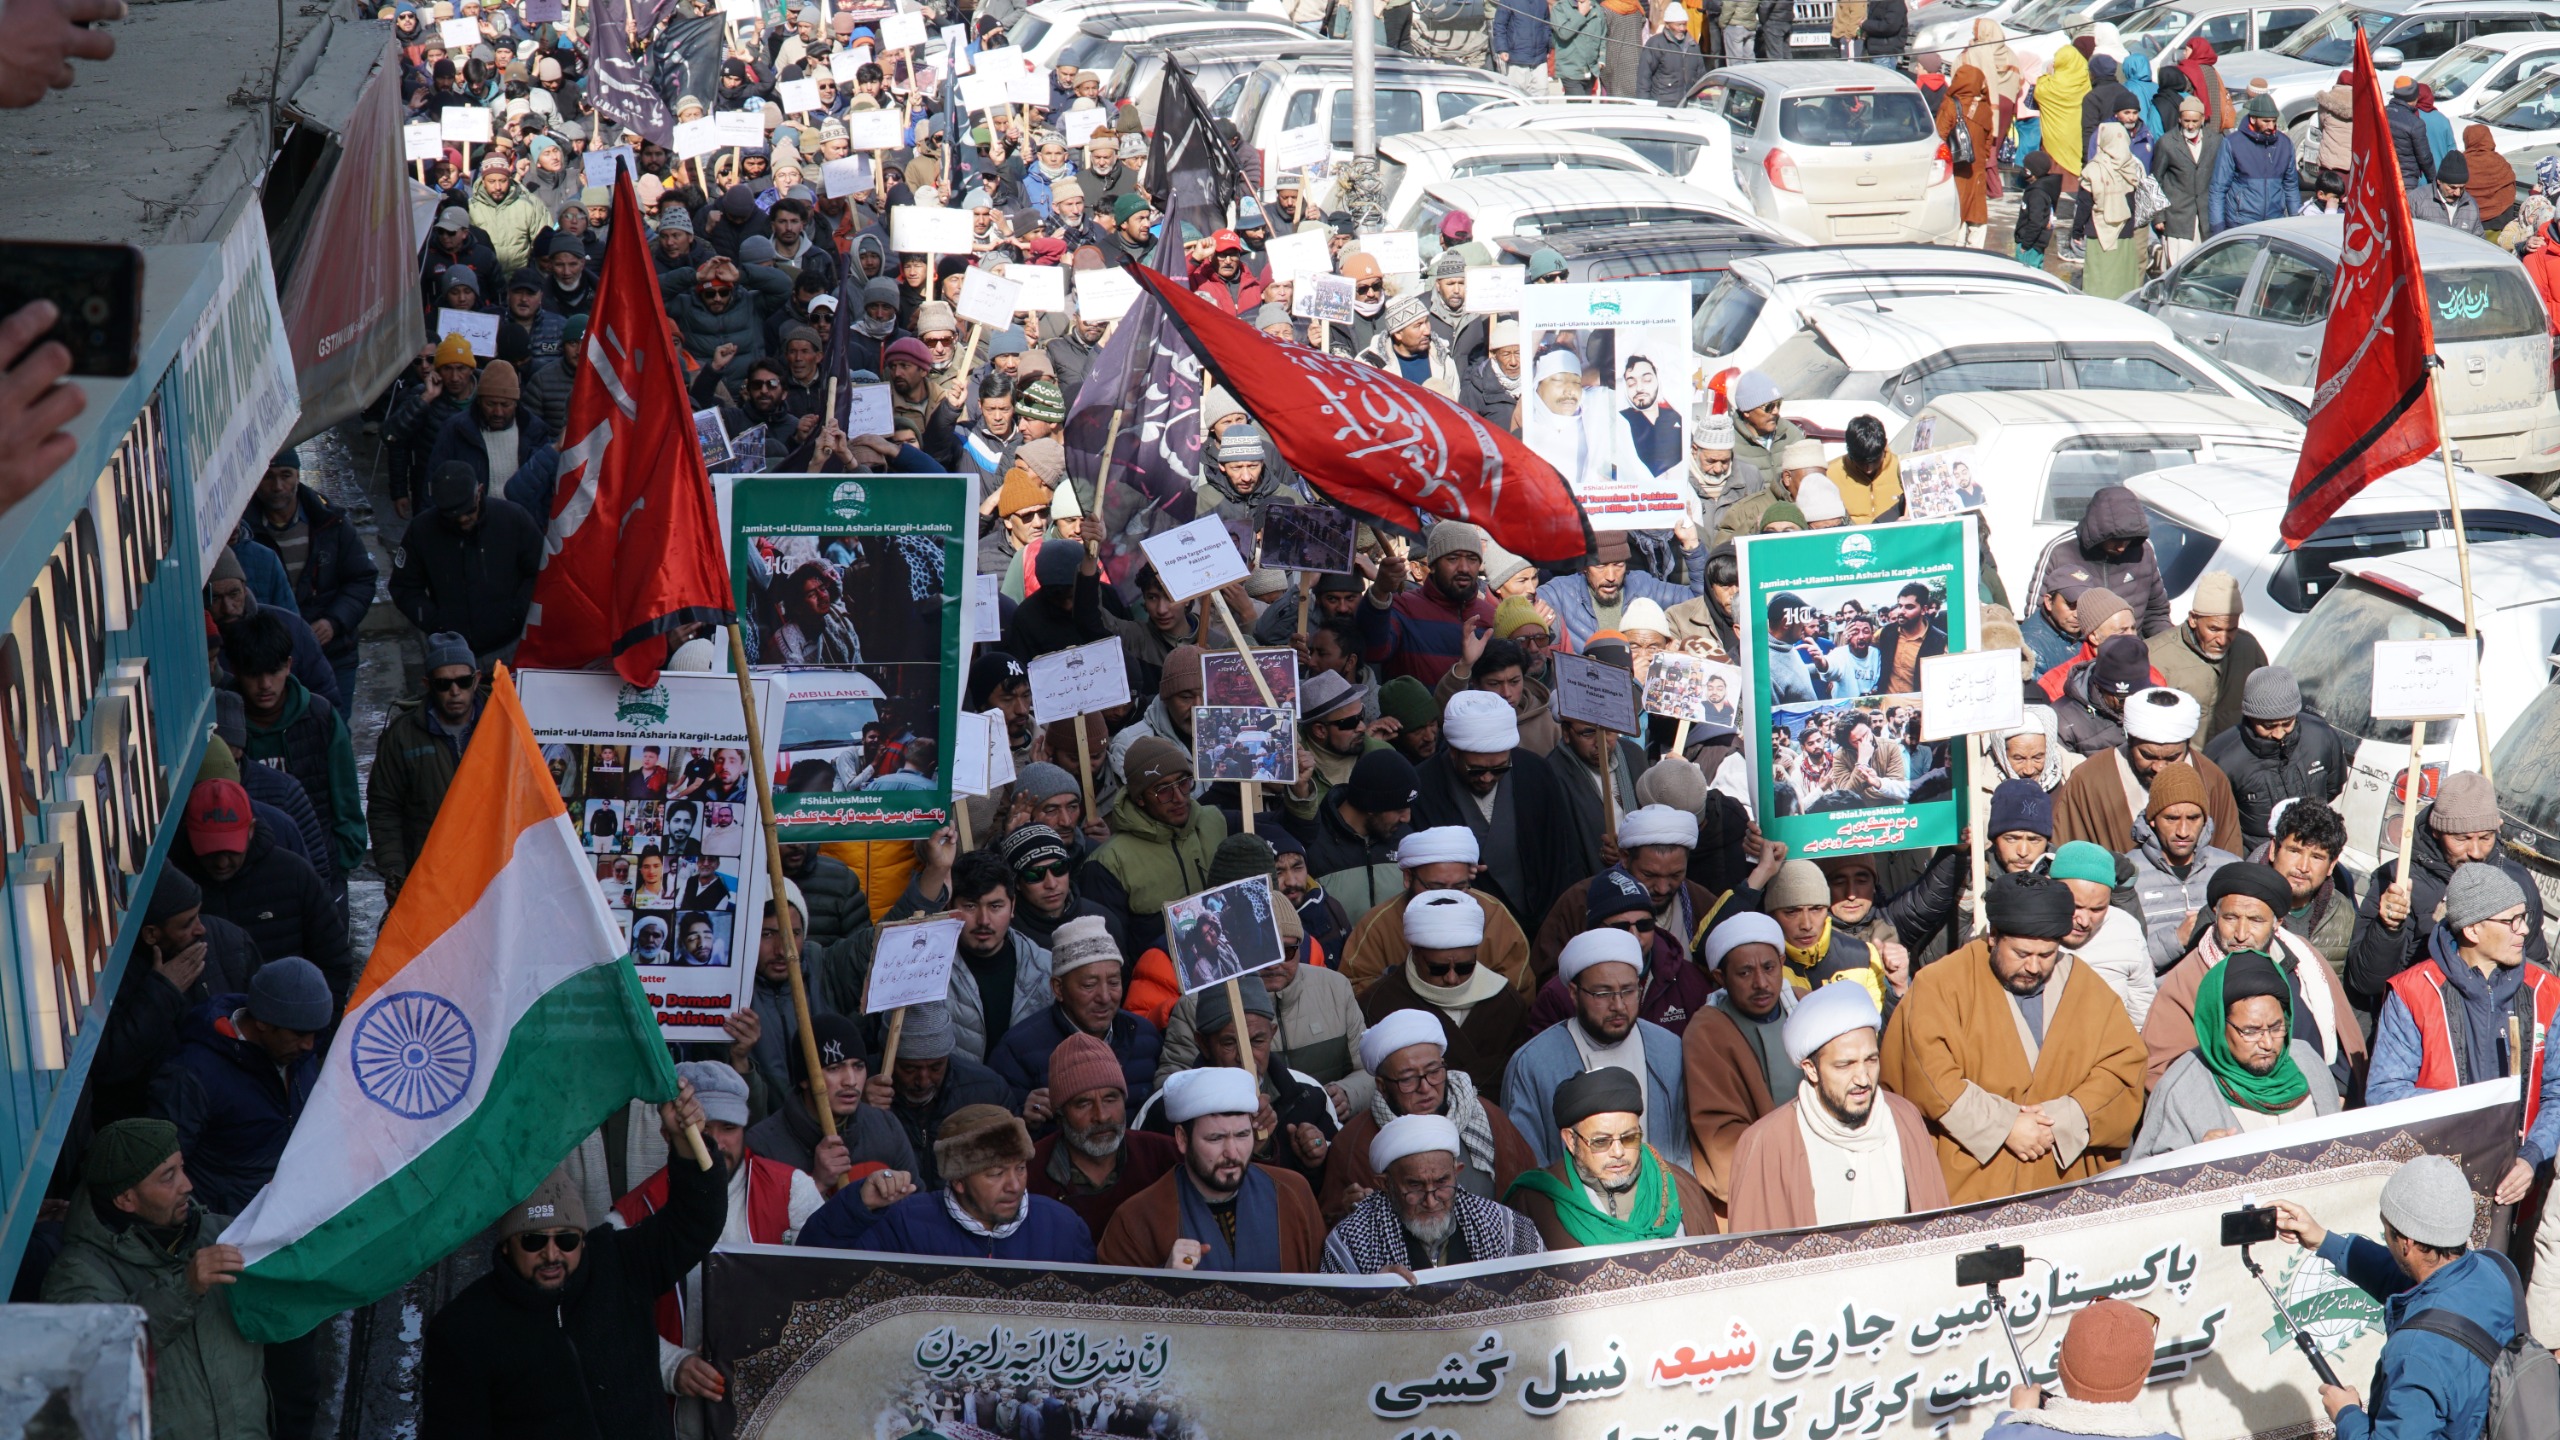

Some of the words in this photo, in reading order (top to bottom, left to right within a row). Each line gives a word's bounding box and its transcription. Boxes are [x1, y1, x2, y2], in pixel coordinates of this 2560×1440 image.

[1630, 318, 1676, 326] Kargil-Ladakh
[1589, 493, 1630, 503] Terrorism
[1631, 492, 1639, 501] in
[1641, 491, 1678, 501] Pakistan
[1605, 504, 1636, 514] Killings
[1638, 503, 1646, 511] in
[1648, 502, 1685, 511] Pakistan
[741, 524, 821, 534] Jamiat-ul-Ulama
[823, 524, 843, 532] Isna
[845, 524, 882, 532] Asharia
[884, 523, 952, 533] Kargil-Ladakh
[1187, 548, 1203, 559] Target
[1189, 554, 1211, 566] Pakistan
[1759, 575, 1834, 590] Jamiat-ul-Ulama
[1835, 573, 1854, 583] Isna
[1855, 570, 1890, 581] Asharia
[1891, 564, 1954, 578] Kargil-Ladakh
[788, 689, 870, 700] AMBULANCE
[616, 730, 637, 739] Isna
[638, 730, 677, 741] Asharia
[800, 796, 882, 805] #ShiaLivesMatter
[203, 807, 239, 823] FILA
[884, 810, 904, 823] میں
[905, 808, 945, 825] پاکستان
[1829, 807, 1905, 820] #ShiaLivesMatter
[14, 656, 170, 1070] KARGIL
[664, 993, 731, 1008] Demand
[657, 1012, 725, 1026] Pakistan
[528, 1204, 554, 1216] BOSS
[2008, 1243, 2198, 1328] پاکستان
[1911, 1297, 1998, 1341] میں
[1772, 1302, 1897, 1374] جاری
[1651, 1321, 1757, 1387] شیعہ
[1523, 1340, 1628, 1410] نسل
[1753, 1396, 1798, 1440] کا
